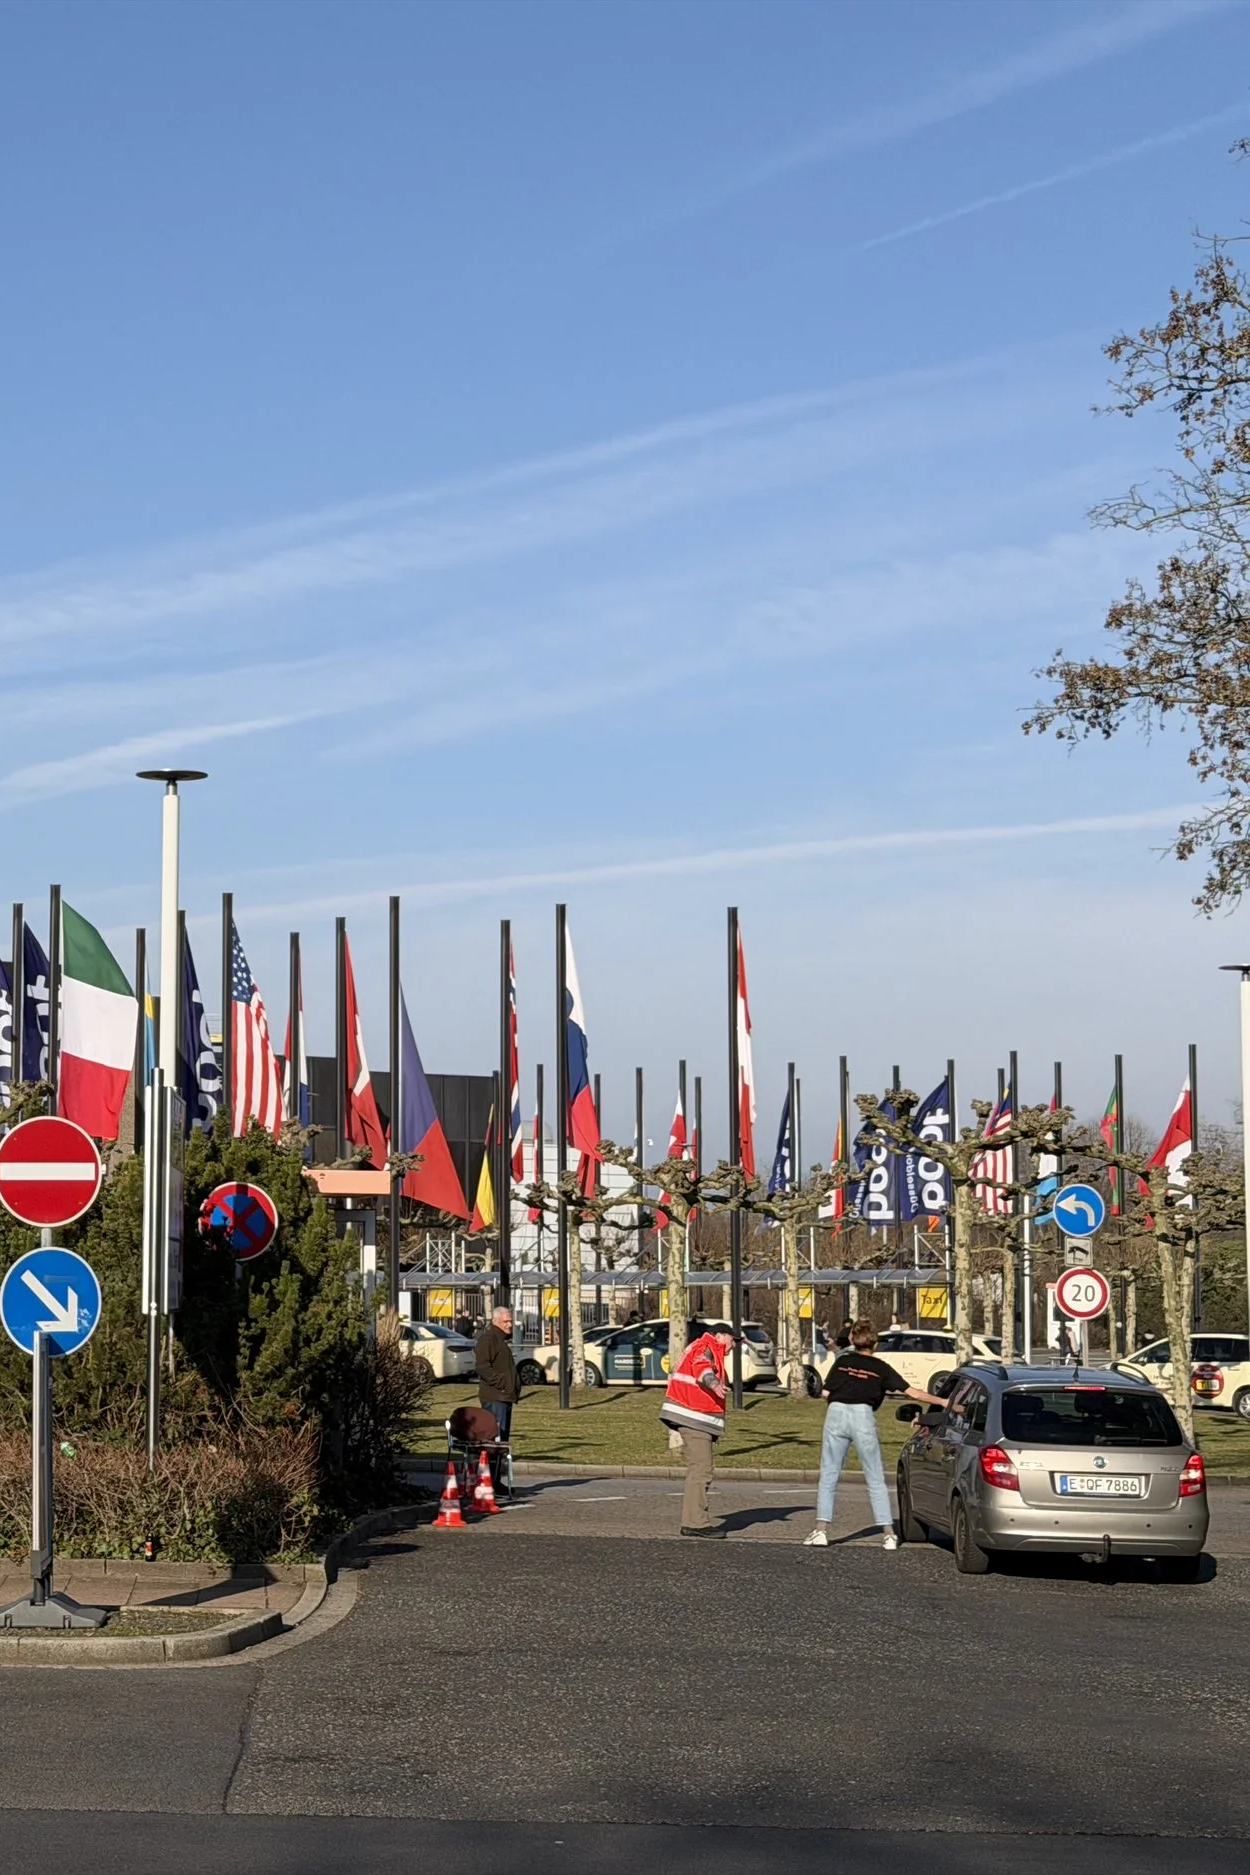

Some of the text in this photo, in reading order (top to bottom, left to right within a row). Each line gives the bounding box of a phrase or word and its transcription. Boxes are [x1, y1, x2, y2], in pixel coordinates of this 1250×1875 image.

[1072, 1284, 1095, 1302] 20
[1069, 1478, 1138, 1492] E QF 7886
